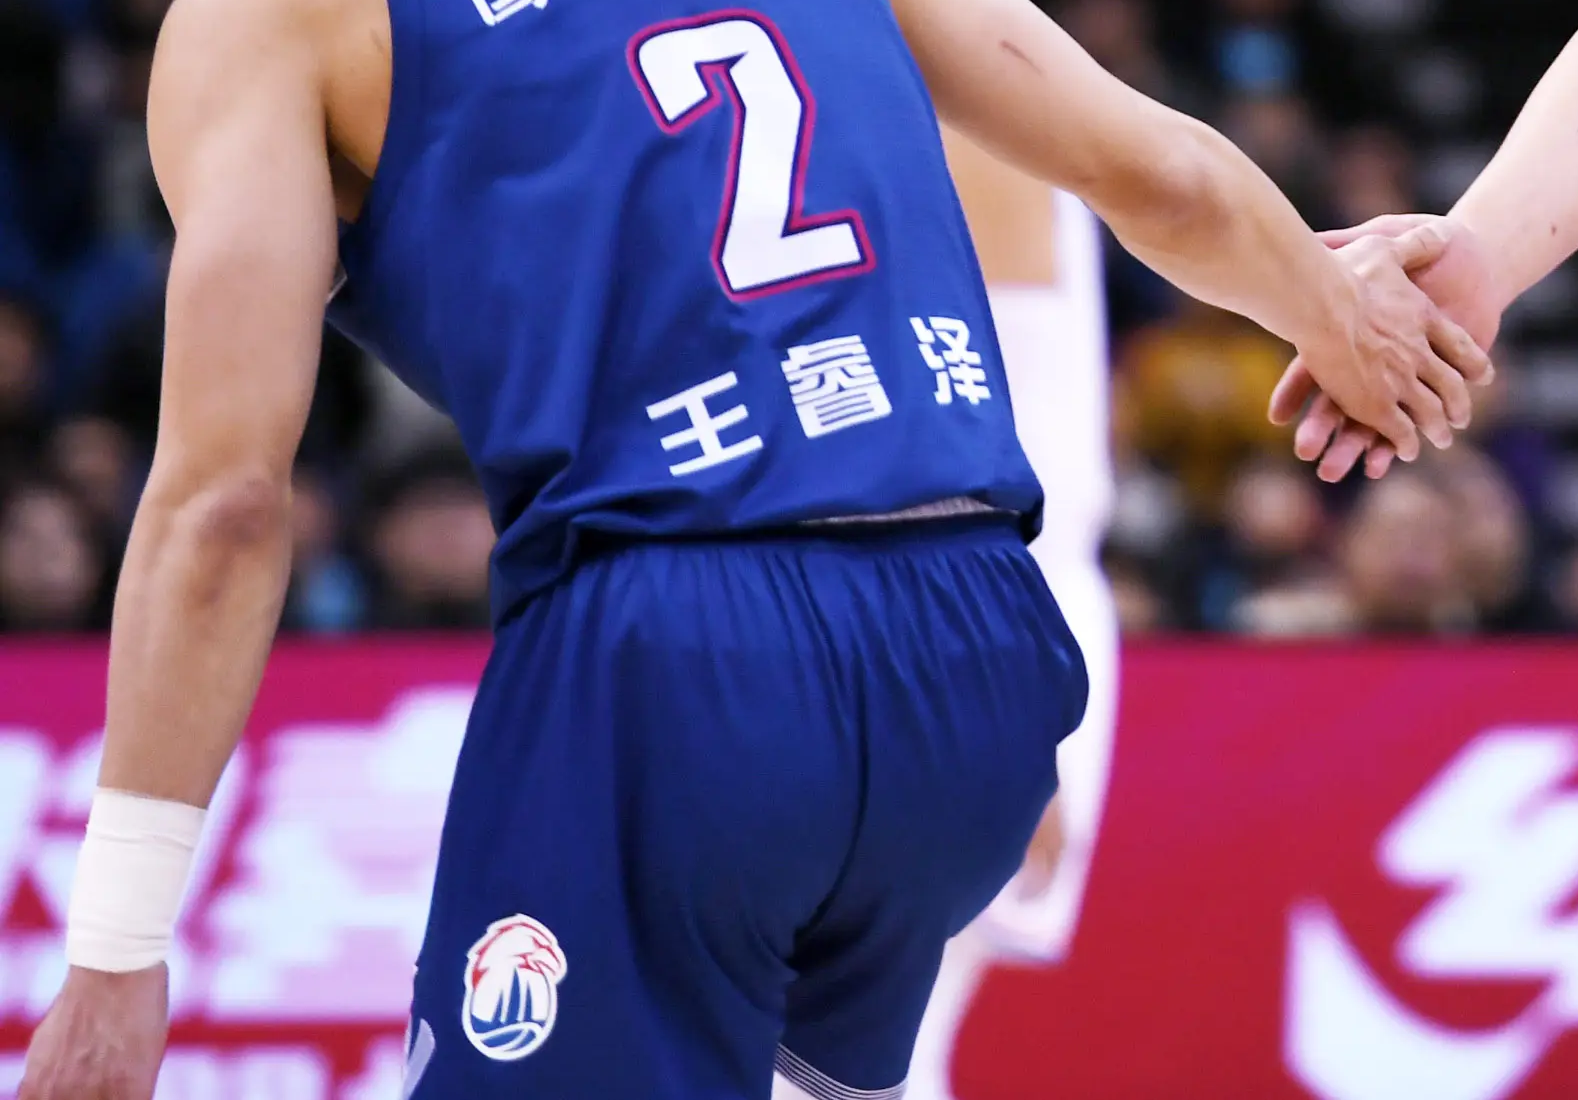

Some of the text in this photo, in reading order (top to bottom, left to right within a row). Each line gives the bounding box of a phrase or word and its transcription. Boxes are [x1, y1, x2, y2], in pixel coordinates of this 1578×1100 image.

[627, 8, 875, 301] 2
[646, 315, 990, 477] 王睿泽
